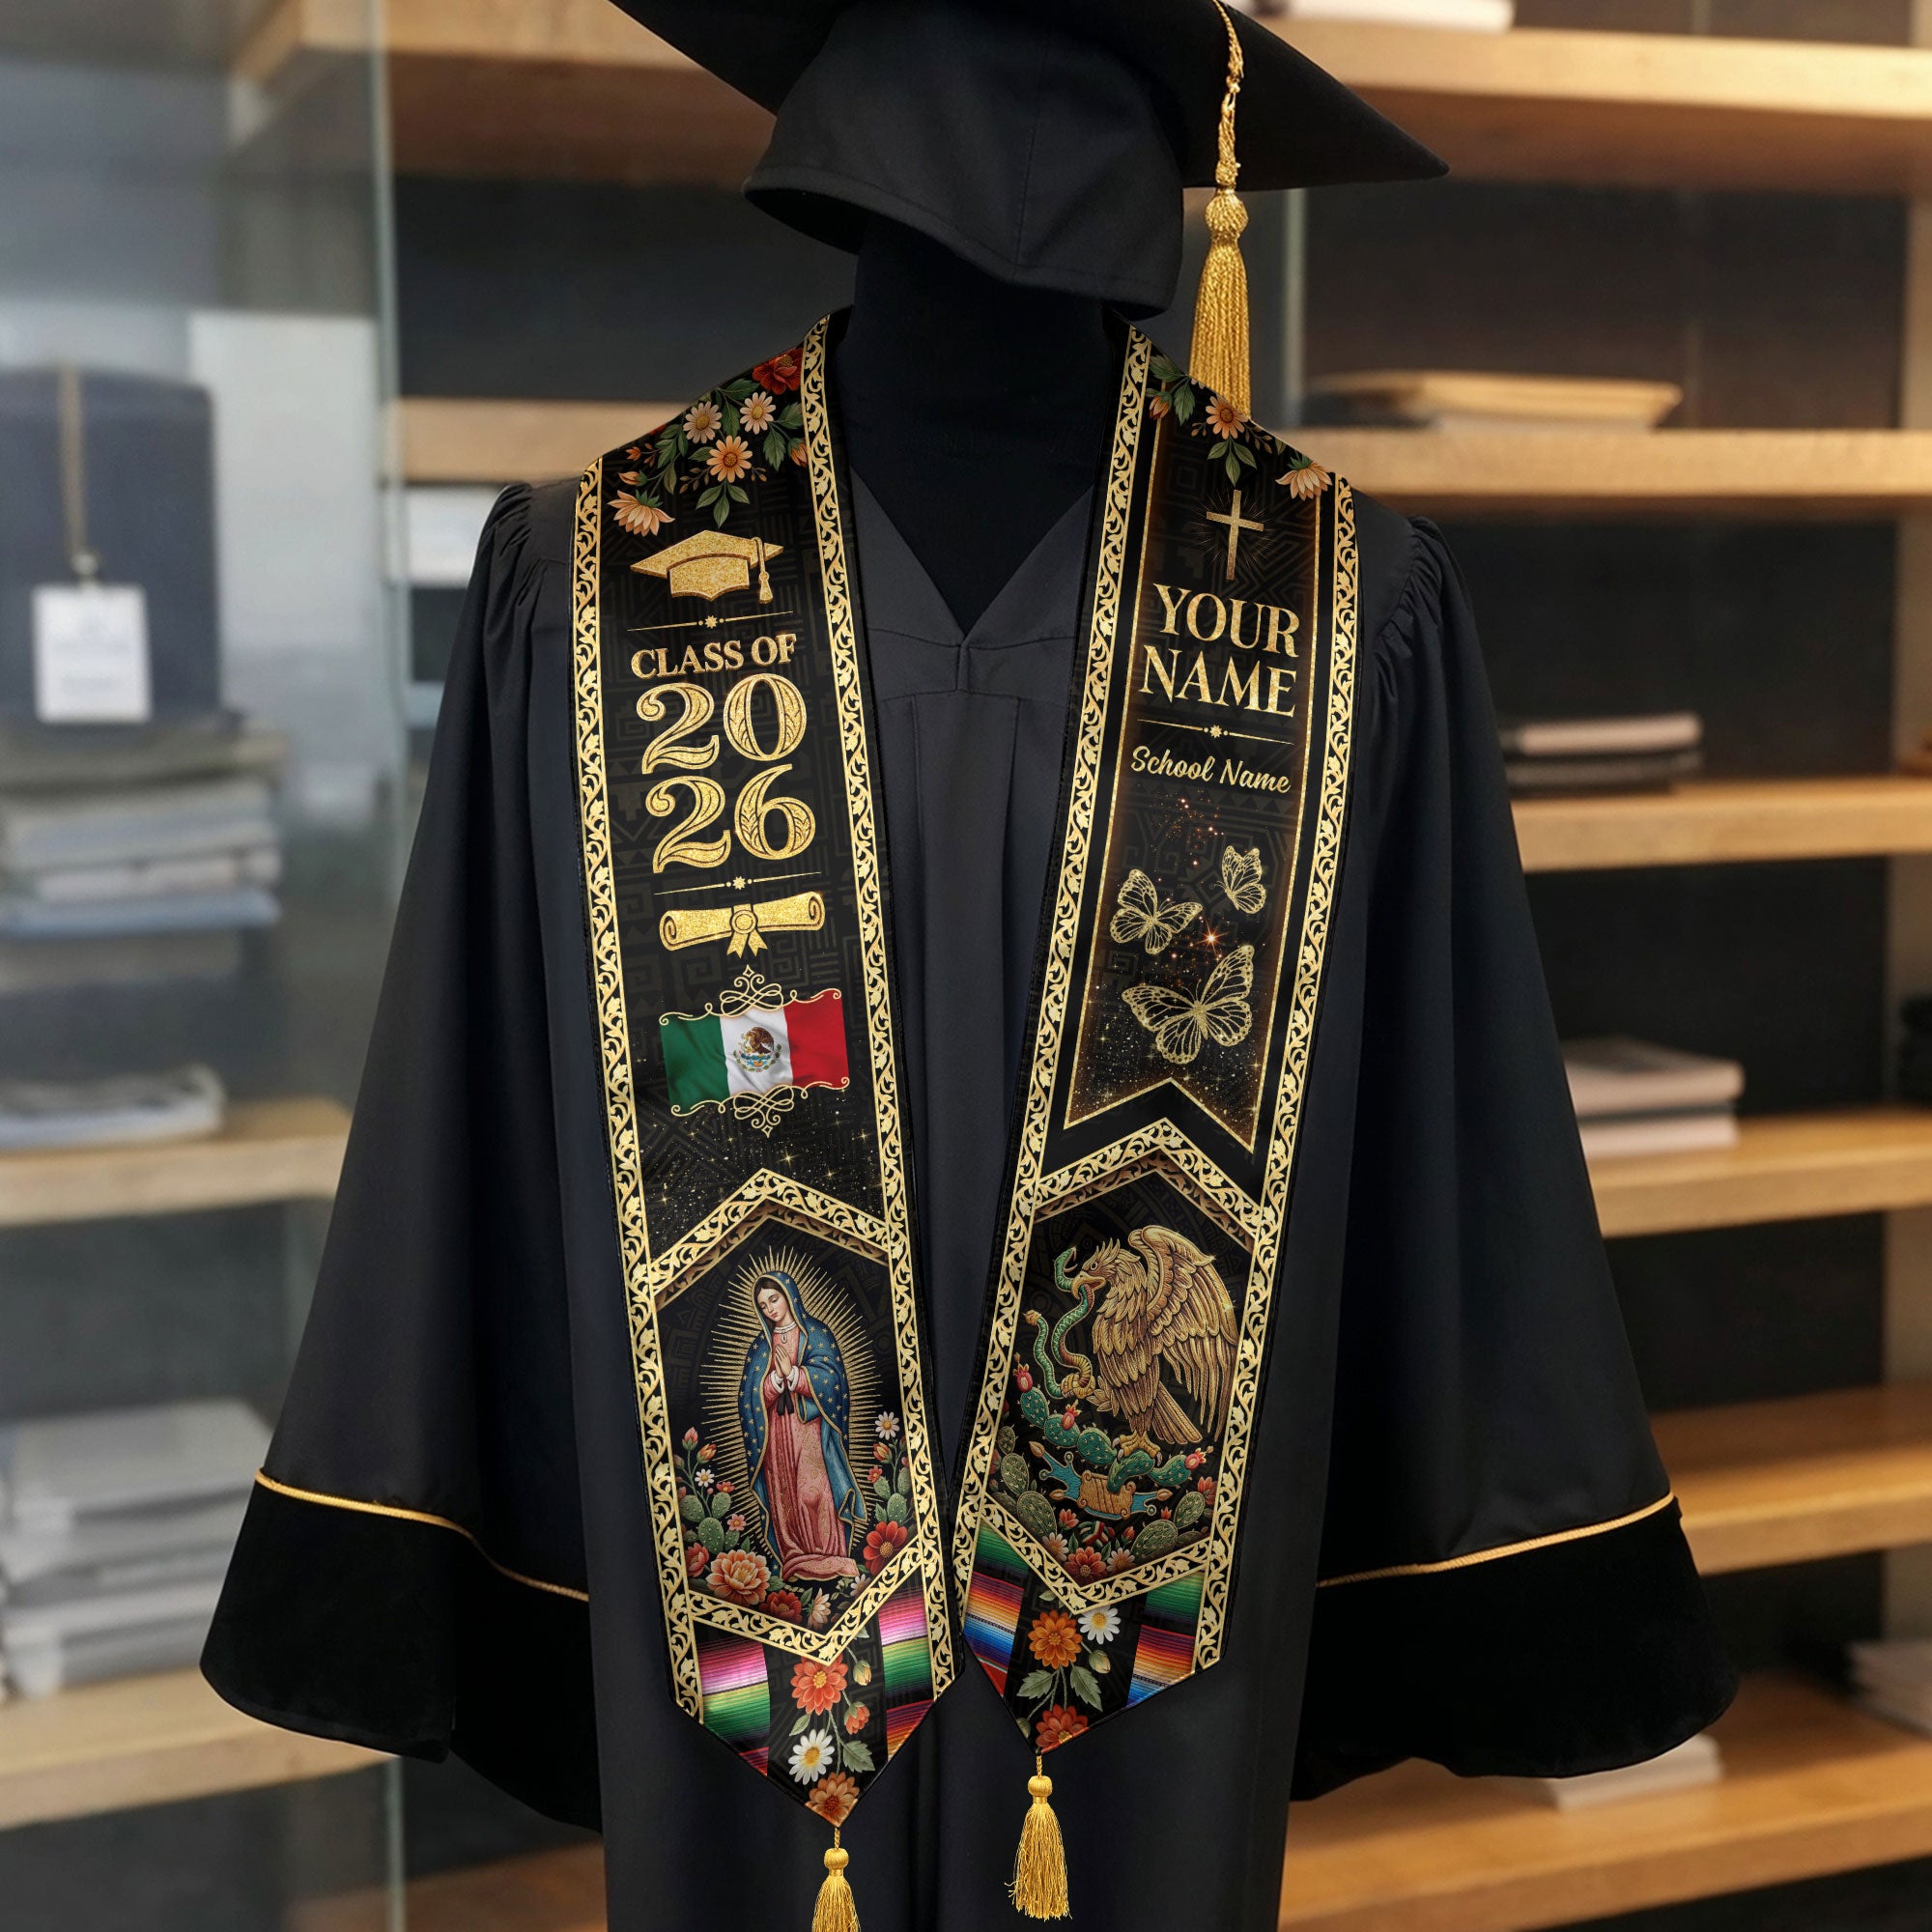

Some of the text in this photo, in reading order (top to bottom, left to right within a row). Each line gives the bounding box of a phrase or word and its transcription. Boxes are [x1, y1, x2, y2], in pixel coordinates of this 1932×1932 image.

[631, 633, 797, 678] CLASS OF
[1152, 583, 1299, 658] YOUR
[1138, 644, 1297, 718] NAME
[636, 672, 807, 774] 20
[1131, 746, 1291, 793] School Name
[645, 763, 815, 873] 26
